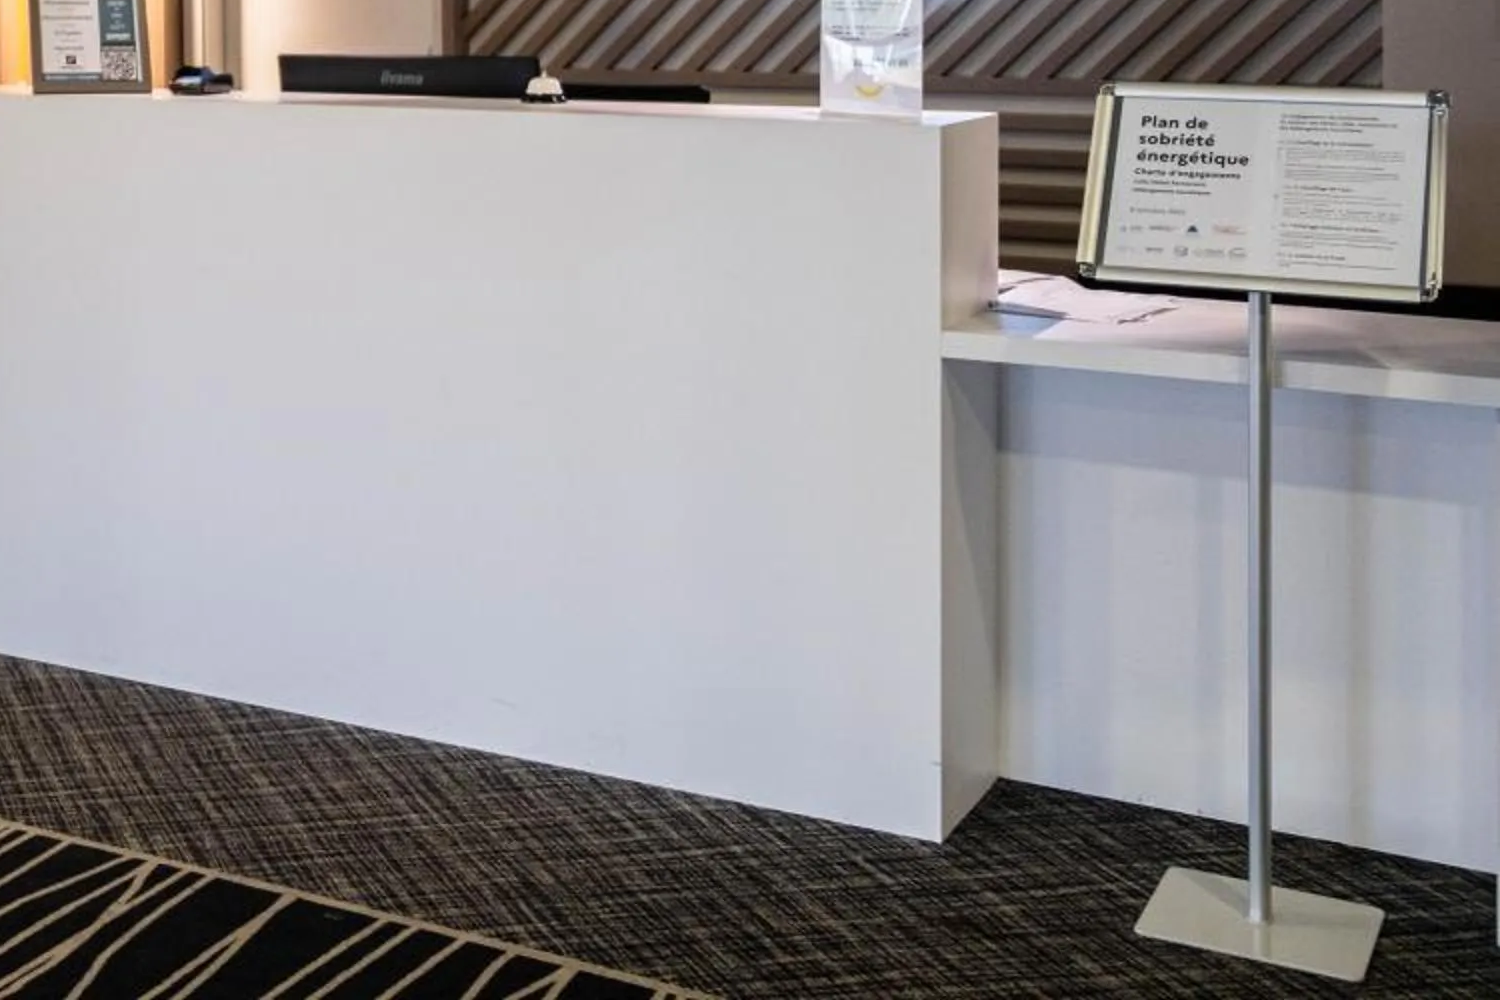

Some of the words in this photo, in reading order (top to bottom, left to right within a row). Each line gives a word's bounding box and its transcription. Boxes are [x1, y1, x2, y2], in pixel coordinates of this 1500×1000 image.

[1141, 115, 1179, 129] Plan
[1185, 116, 1209, 130] de
[1139, 133, 1216, 147] sobriété
[1136, 149, 1250, 168] énergétique
